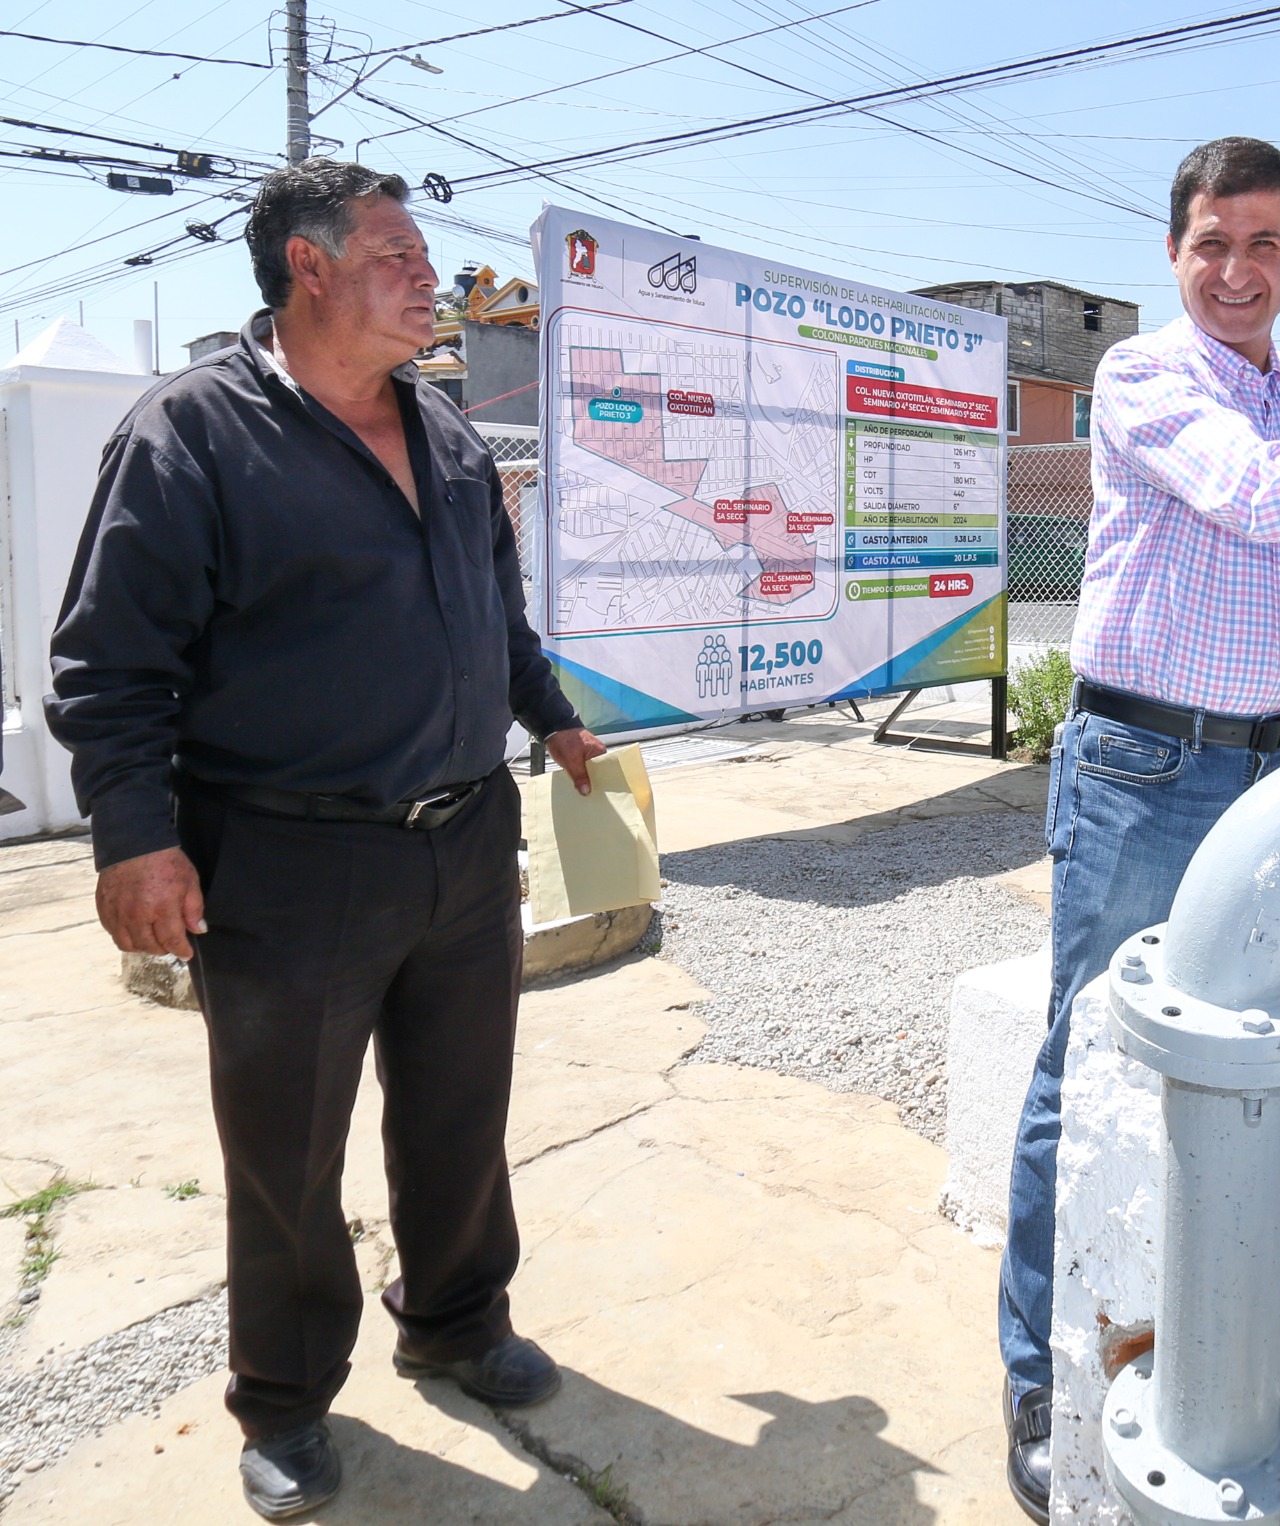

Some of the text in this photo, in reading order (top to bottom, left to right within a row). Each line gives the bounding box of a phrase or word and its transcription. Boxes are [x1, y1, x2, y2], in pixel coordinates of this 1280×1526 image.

[638, 289, 650, 298] Agua
[655, 292, 685, 303] Saneamiento
[692, 298, 705, 306] Toluca
[764, 270, 964, 326] SUPERVISIÓN DE LA REHABILITACIÓN DEL
[735, 282, 806, 320] POZO
[891, 316, 959, 350] PRIETO
[812, 328, 928, 358] COLONIA PARQUES NACIONALES
[854, 364, 900, 378] DISTRIBUCIÓN
[688, 395, 712, 403] NUEVA
[855, 386, 870, 396] COL.
[872, 388, 895, 399] NUEVA
[896, 392, 935, 404] OXTOTITLÁN,
[936, 397, 968, 409] SEMINARIO
[595, 402, 636, 412] POZO LODO
[670, 403, 713, 414] OXTOTITLÁN
[864, 398, 900, 409] SEMINARIO
[931, 407, 963, 418] SEMINARIO
[599, 410, 625, 419] PRIETO
[864, 424, 878, 434] AÑO
[890, 428, 933, 439] PERFORACIÓN
[953, 434, 966, 442] 1987
[864, 441, 910, 451] PROFUNDIDAD
[954, 448, 962, 456] 126
[864, 471, 876, 479] CDT
[864, 487, 883, 495] VOLTS
[954, 490, 965, 498] 440
[733, 503, 770, 511] SEMINARIO
[864, 501, 920, 510] SALIDA DIÁMETRO
[863, 514, 938, 524] AÑO DE REHABILITACIÓN
[863, 536, 928, 544] GASTO ANTERIOR
[862, 556, 920, 565] GASTO ACTUAL
[777, 574, 811, 582] SEMINARIO
[862, 583, 927, 595] TIEMPO DE OPERACIÓN
[934, 579, 969, 591] 24 HRS.
[738, 639, 823, 675] 12,500
[740, 672, 814, 692] HABITANTES
